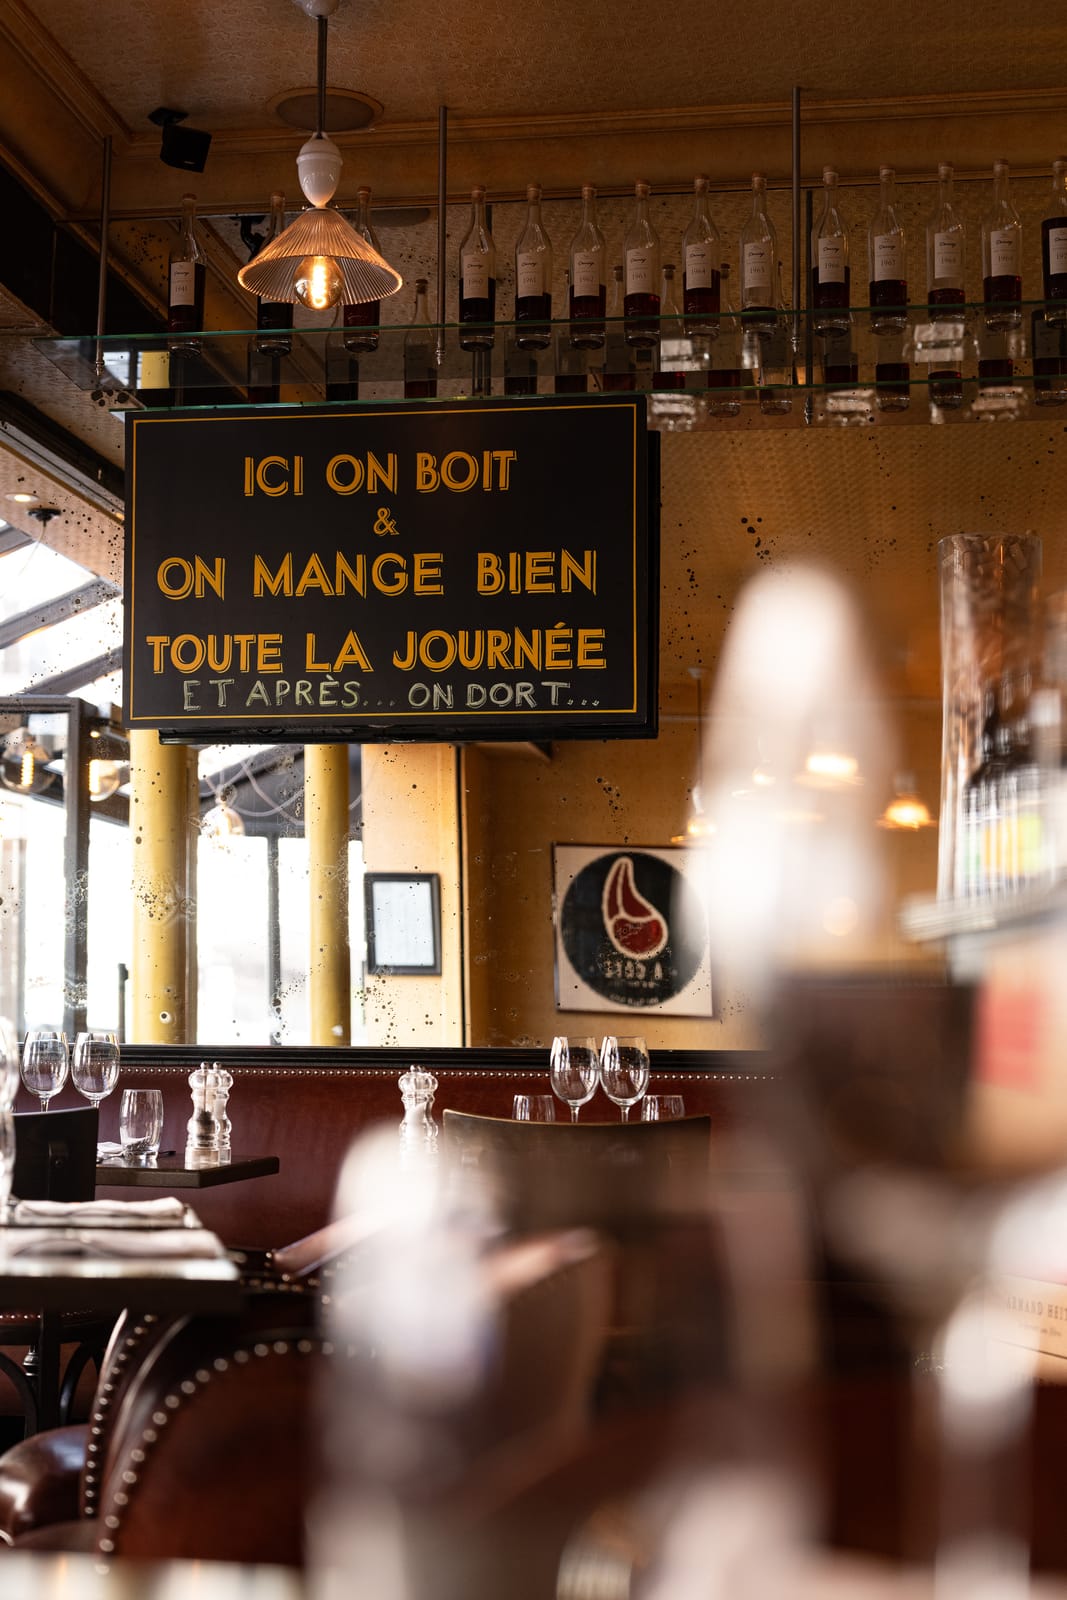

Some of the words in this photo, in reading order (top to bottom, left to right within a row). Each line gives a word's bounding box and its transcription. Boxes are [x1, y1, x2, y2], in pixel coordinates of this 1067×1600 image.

[244, 456, 303, 496] ICI
[326, 452, 398, 495] ON
[416, 450, 517, 493] BOIT
[373, 508, 400, 537] &
[157, 555, 225, 600] ON
[253, 551, 444, 598] MANGE
[477, 549, 597, 595] BIEN
[146, 634, 284, 674] TOUTE
[305, 630, 375, 672] LA
[392, 622, 606, 671] JOURNÉE
[183, 678, 235, 712] ET
[408, 682, 454, 710] ON
